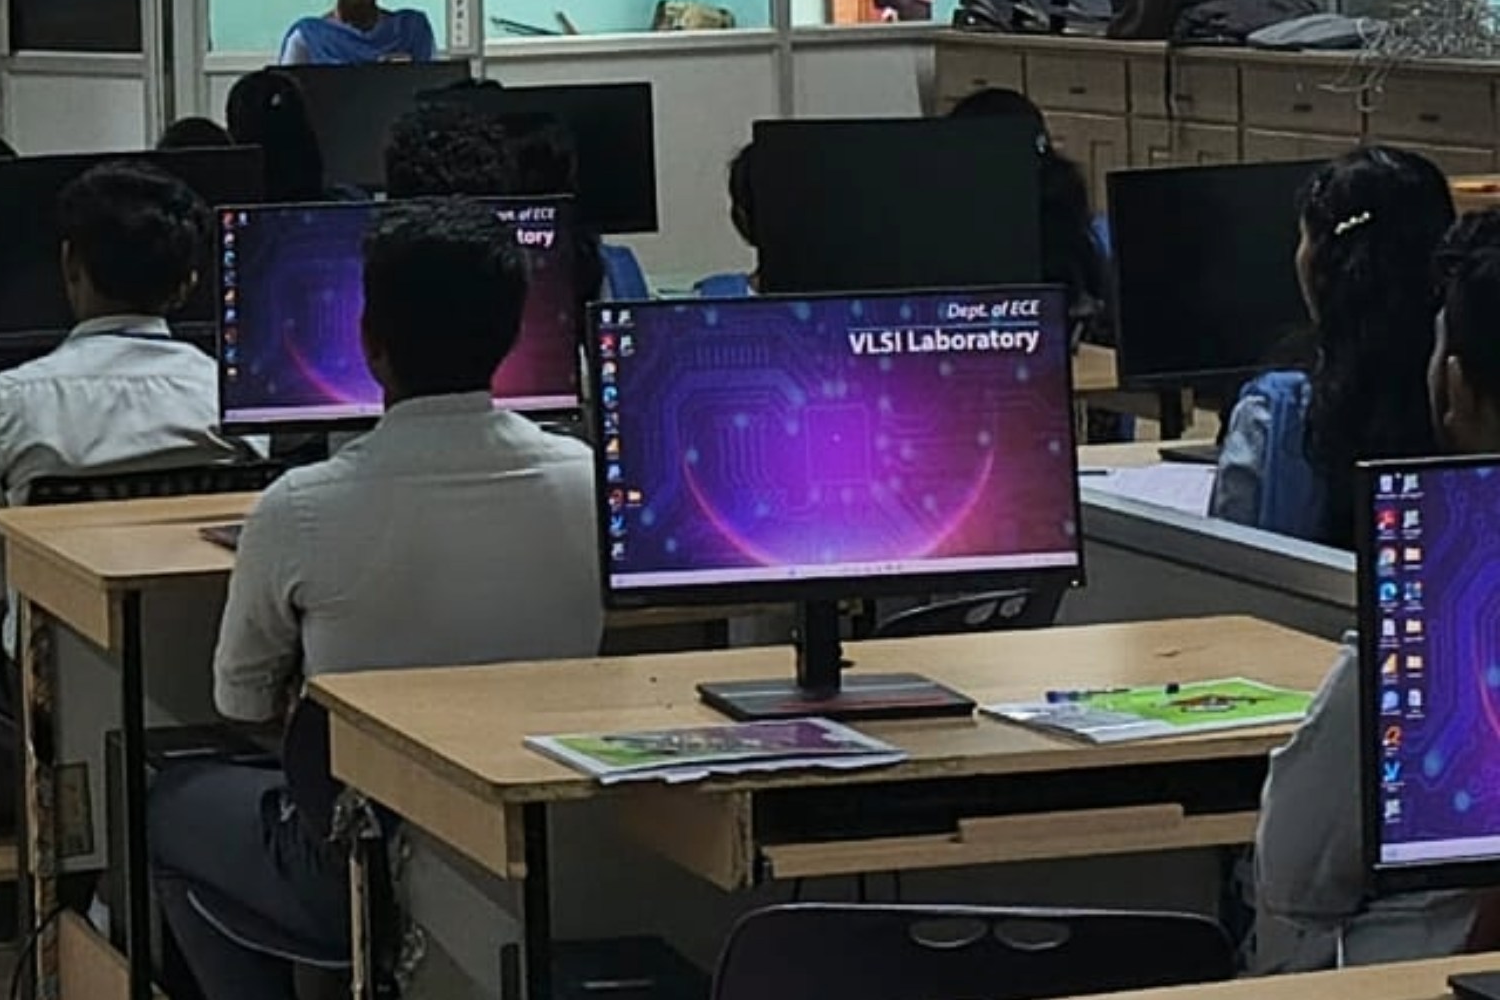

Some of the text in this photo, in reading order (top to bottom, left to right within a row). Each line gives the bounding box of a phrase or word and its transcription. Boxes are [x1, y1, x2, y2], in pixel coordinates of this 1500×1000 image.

[946, 299, 1040, 321] Dept. of ECE
[849, 329, 1040, 354] VLSI Laboratory
